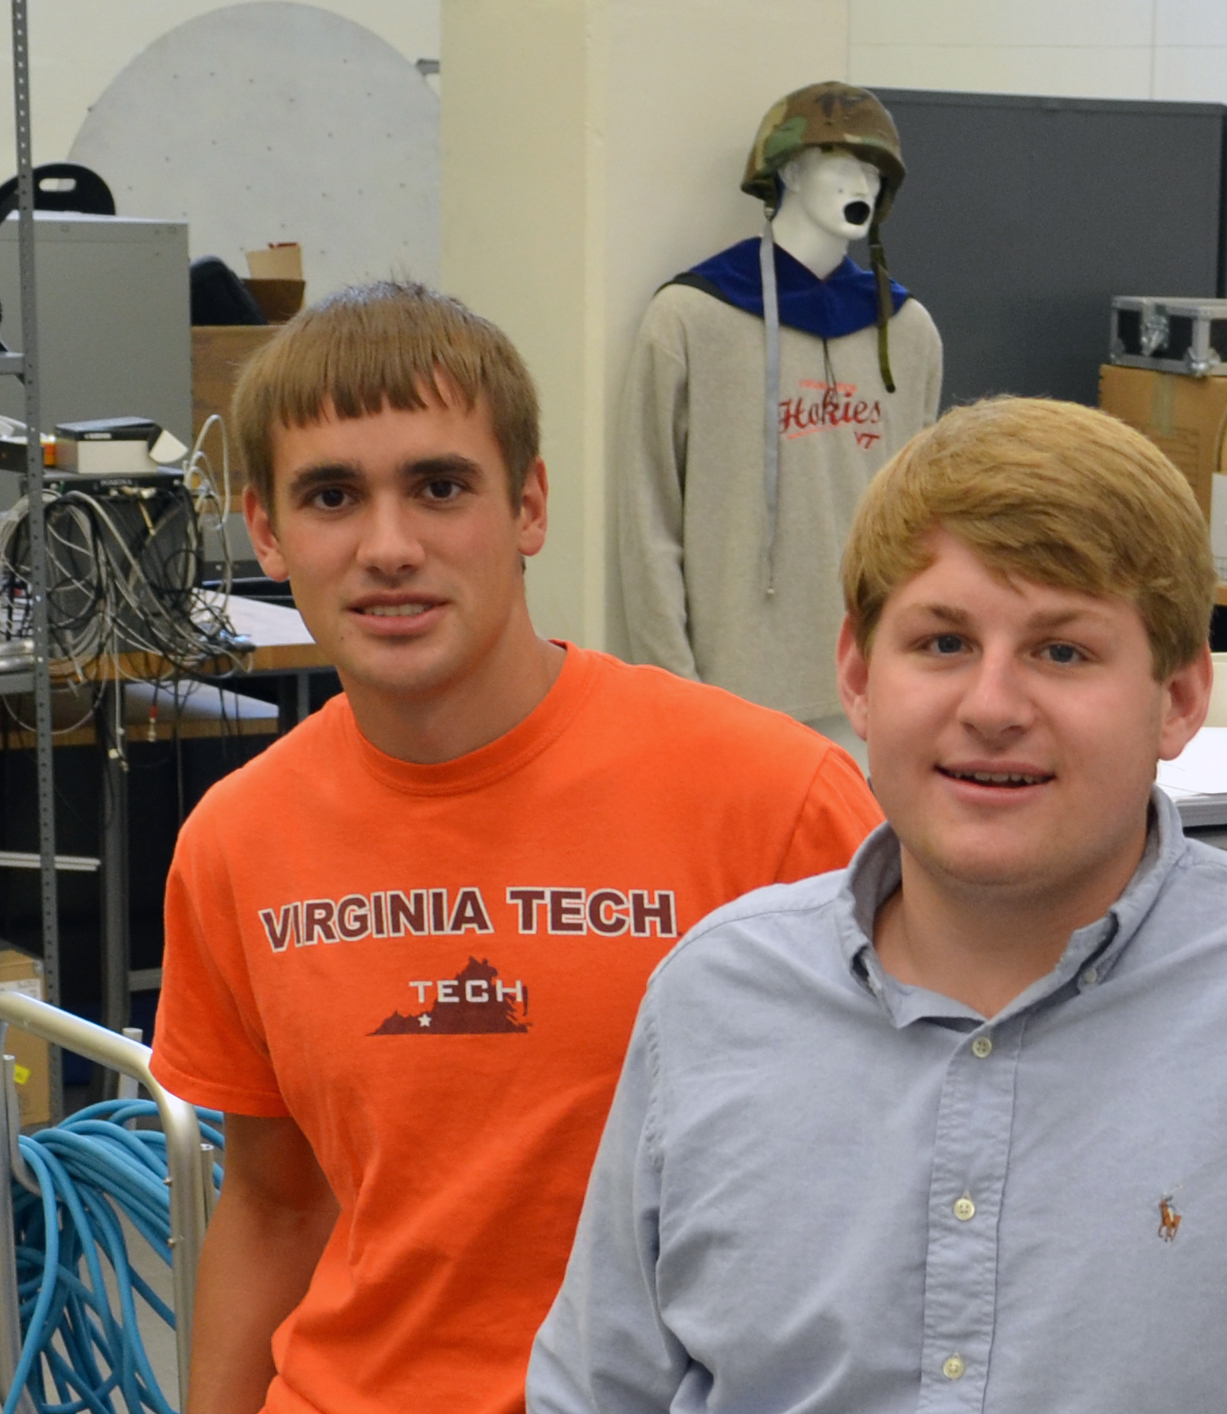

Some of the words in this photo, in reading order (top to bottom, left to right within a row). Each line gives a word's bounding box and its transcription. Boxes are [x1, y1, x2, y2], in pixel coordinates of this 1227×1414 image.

[778, 388, 881, 434] Hokies
[259, 887, 494, 953] VIRGINIA
[506, 887, 678, 937] TECH
[408, 979, 524, 1003] TECH
